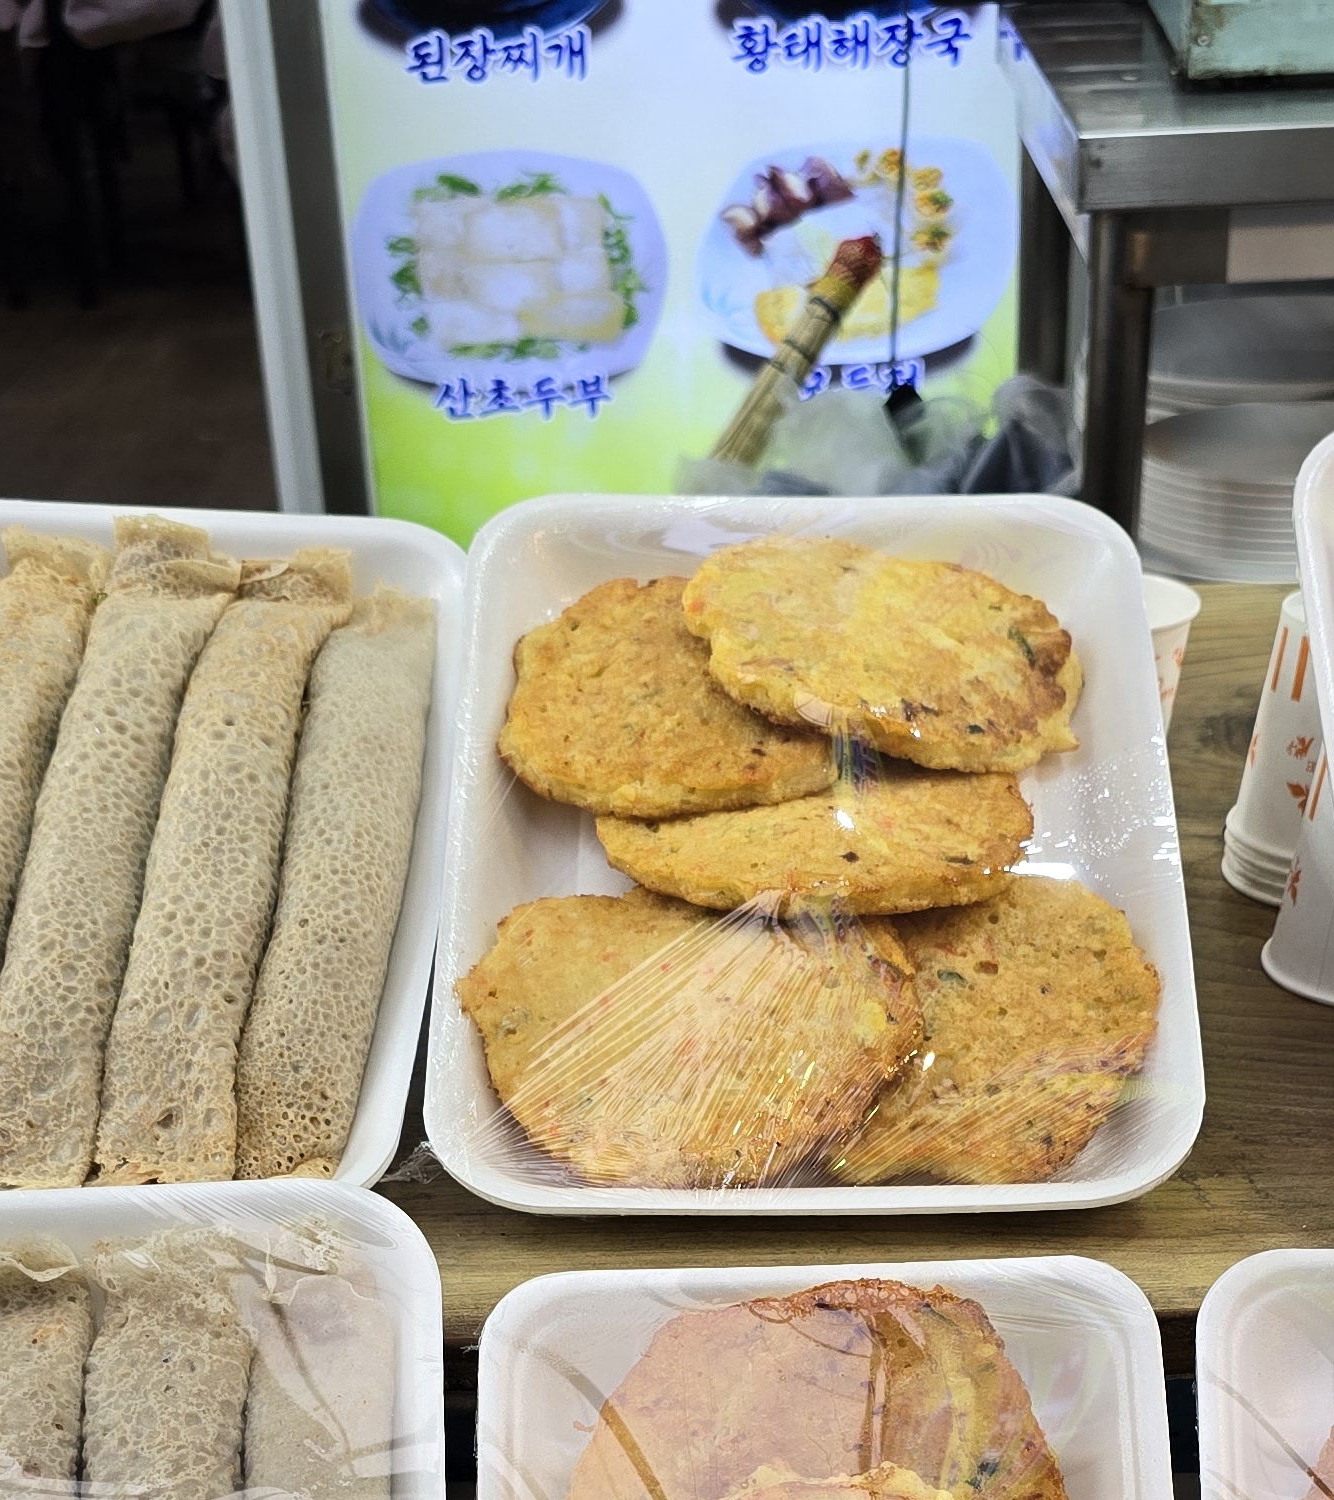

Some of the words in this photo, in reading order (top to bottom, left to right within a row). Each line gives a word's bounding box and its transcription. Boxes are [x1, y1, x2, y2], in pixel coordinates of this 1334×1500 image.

[408, 25, 589, 81] 된장찌개
[736, 16, 969, 73] 황태해장국
[437, 370, 611, 419] 산초두부
